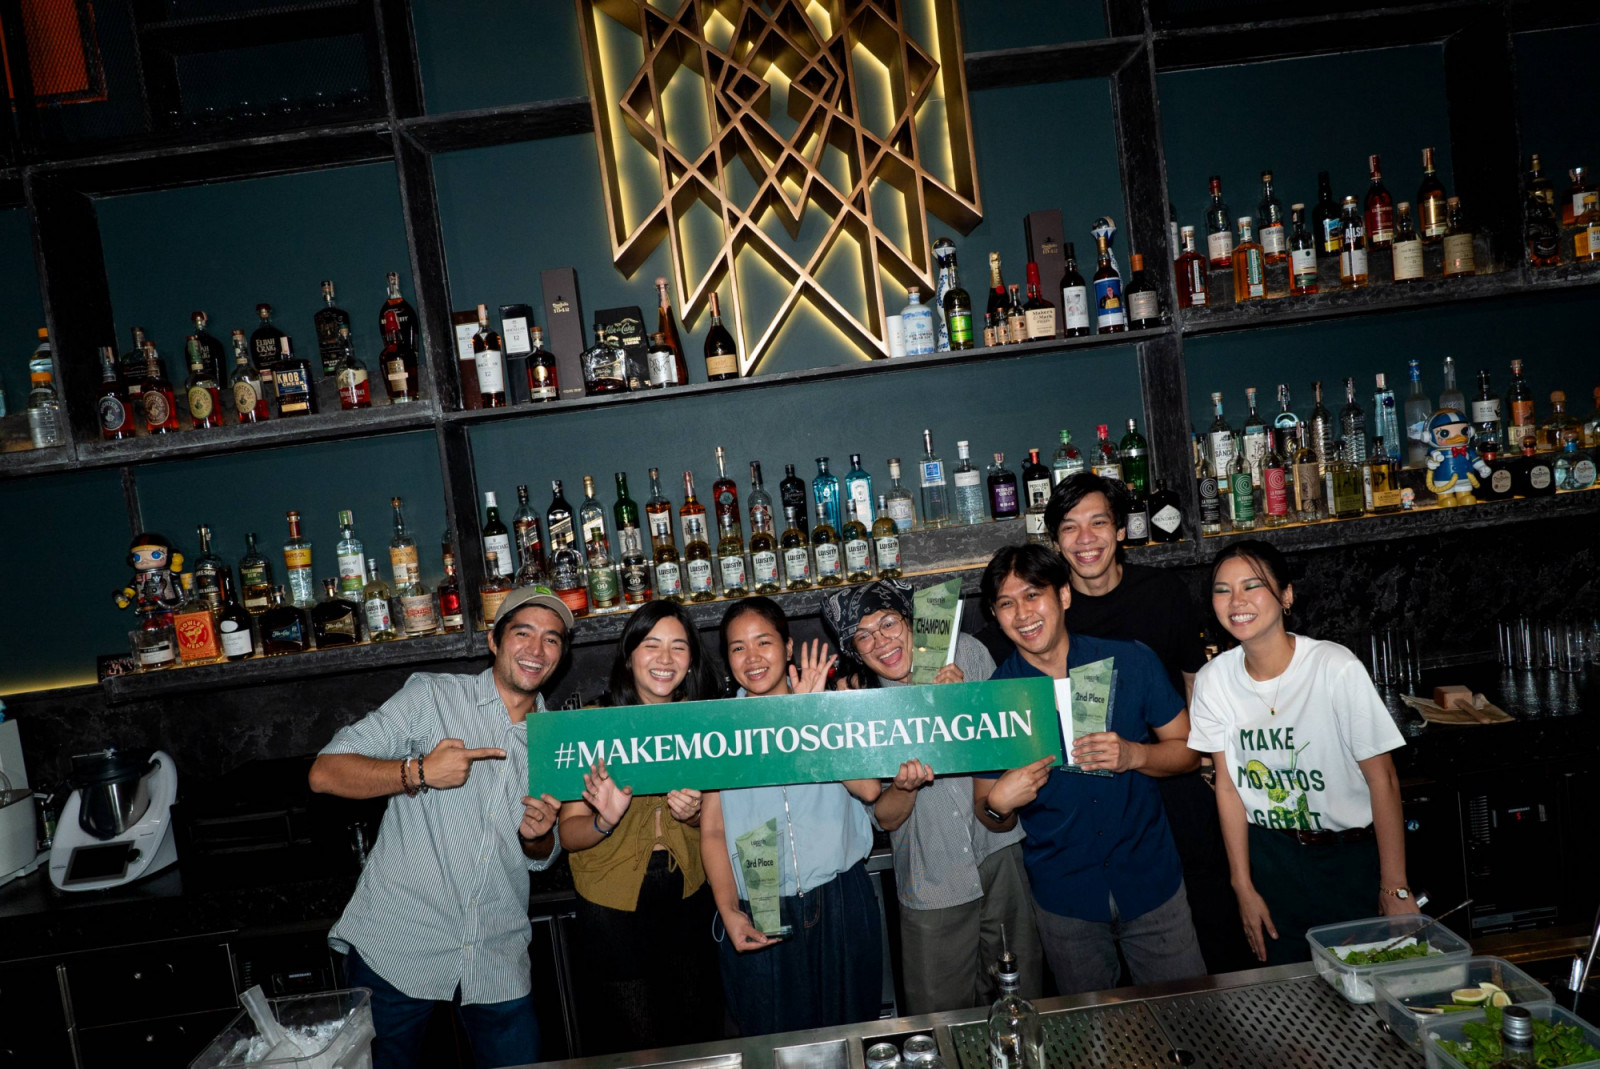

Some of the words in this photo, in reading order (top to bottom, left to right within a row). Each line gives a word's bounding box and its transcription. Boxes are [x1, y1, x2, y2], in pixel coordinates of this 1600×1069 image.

[277, 371, 300, 384] KNOB
[179, 619, 205, 632] HOWLER
[916, 617, 951, 635] CHAMPION
[186, 641, 204, 649] HEAD
[1075, 692, 1088, 702] 2nd
[1088, 692, 1105, 704] Place
[554, 710, 1032, 769] #MAKEMOJITOSGREATAGAIN
[1239, 727, 1295, 751] MAKE
[1237, 766, 1326, 792] MOJITOS
[1253, 809, 1322, 831] GREAT
[746, 859, 757, 868] 3rd
[757, 858, 774, 867] Place
